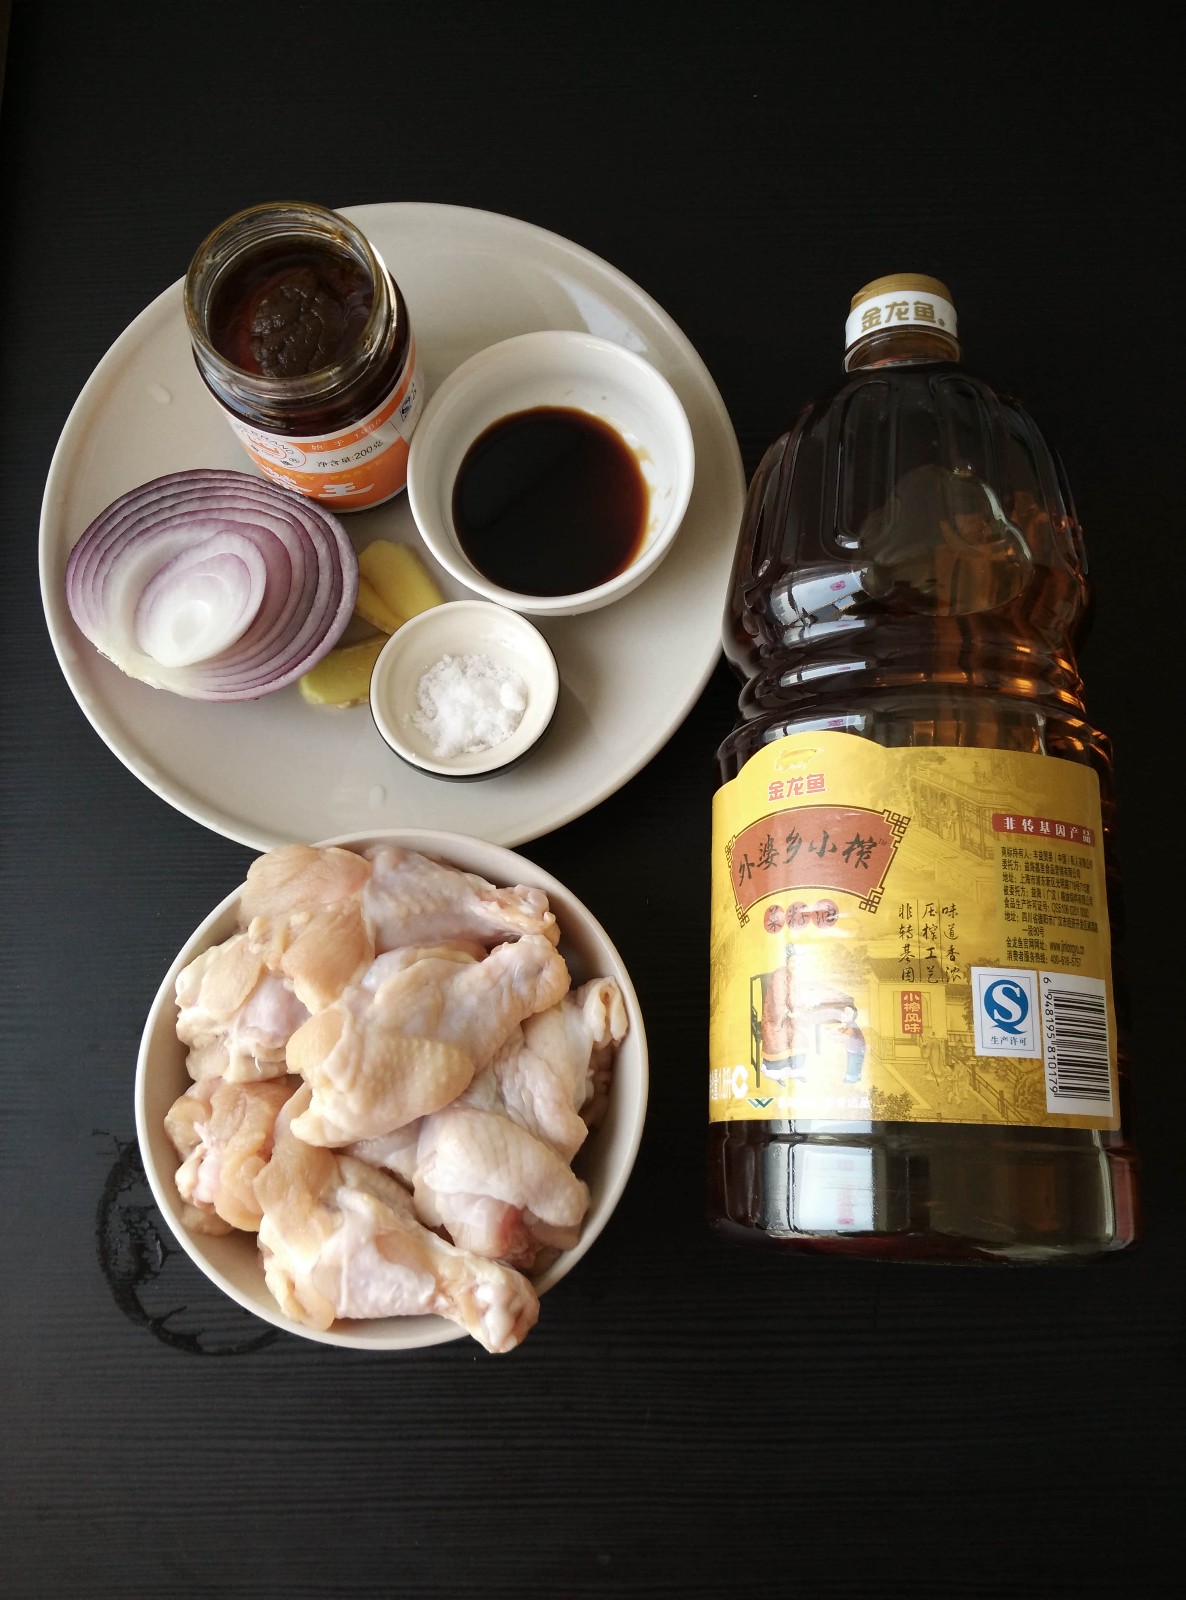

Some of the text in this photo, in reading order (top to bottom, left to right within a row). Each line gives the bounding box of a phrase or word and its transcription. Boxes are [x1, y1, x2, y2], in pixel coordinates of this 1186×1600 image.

[862, 301, 935, 332] 金龙鱼
[768, 773, 826, 801] 金龙鱼
[1003, 816, 1092, 844] 非转基因产品
[899, 903, 915, 983] 非转基因
[921, 902, 939, 984] 压榨工艺
[941, 902, 962, 983] 味道香浓
[903, 992, 922, 1033] 小榨风味
[990, 1035, 1028, 1047] 生产许可
[1043, 976, 1059, 1093] 6 948195 810179
